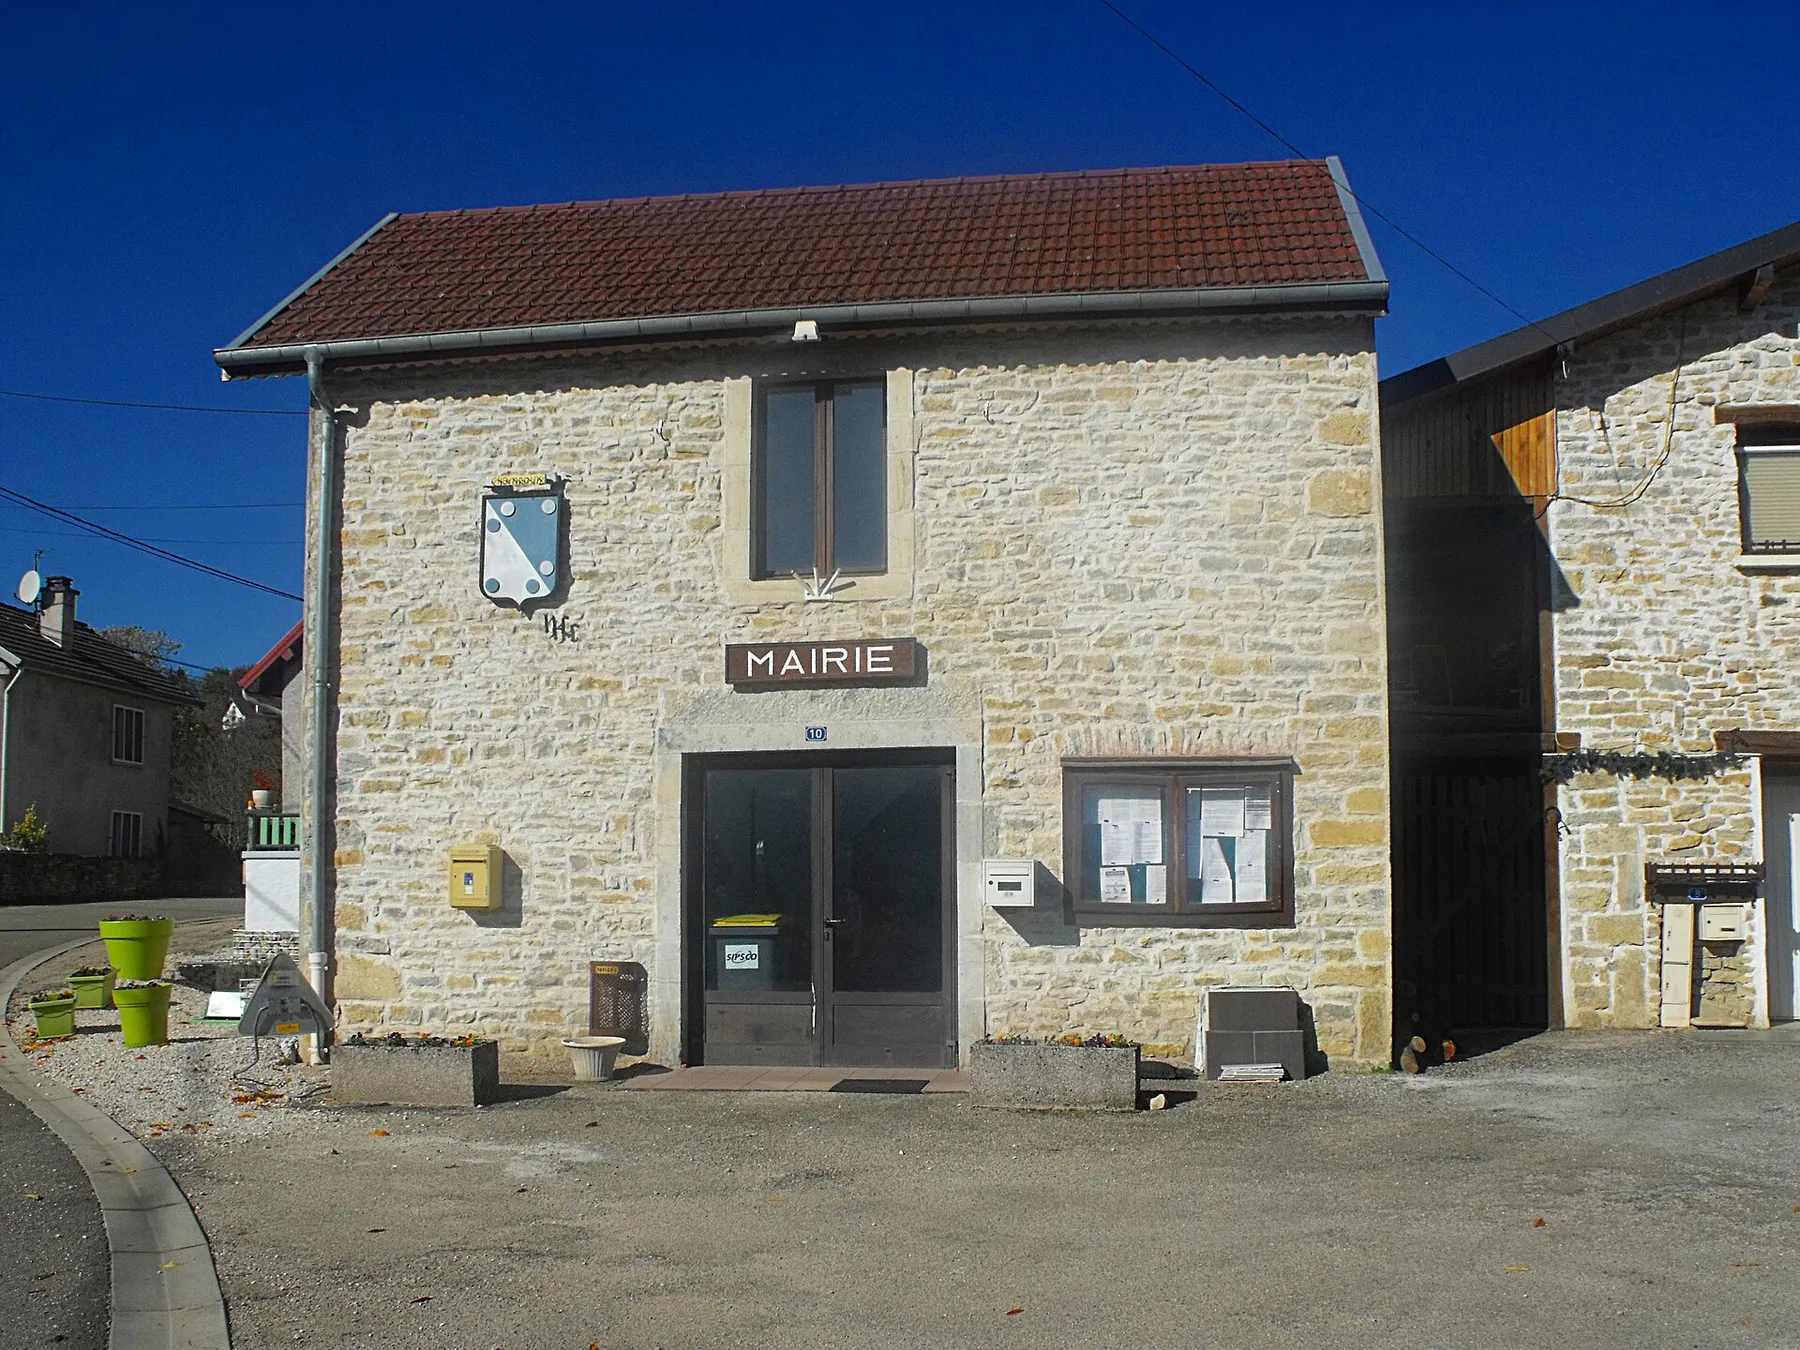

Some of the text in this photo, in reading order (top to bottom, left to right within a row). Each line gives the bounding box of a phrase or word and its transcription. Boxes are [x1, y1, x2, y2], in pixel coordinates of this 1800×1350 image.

[747, 645, 894, 677] MAIRIE
[809, 728, 823, 739] 10
[726, 950, 757, 962] SIPSCO
